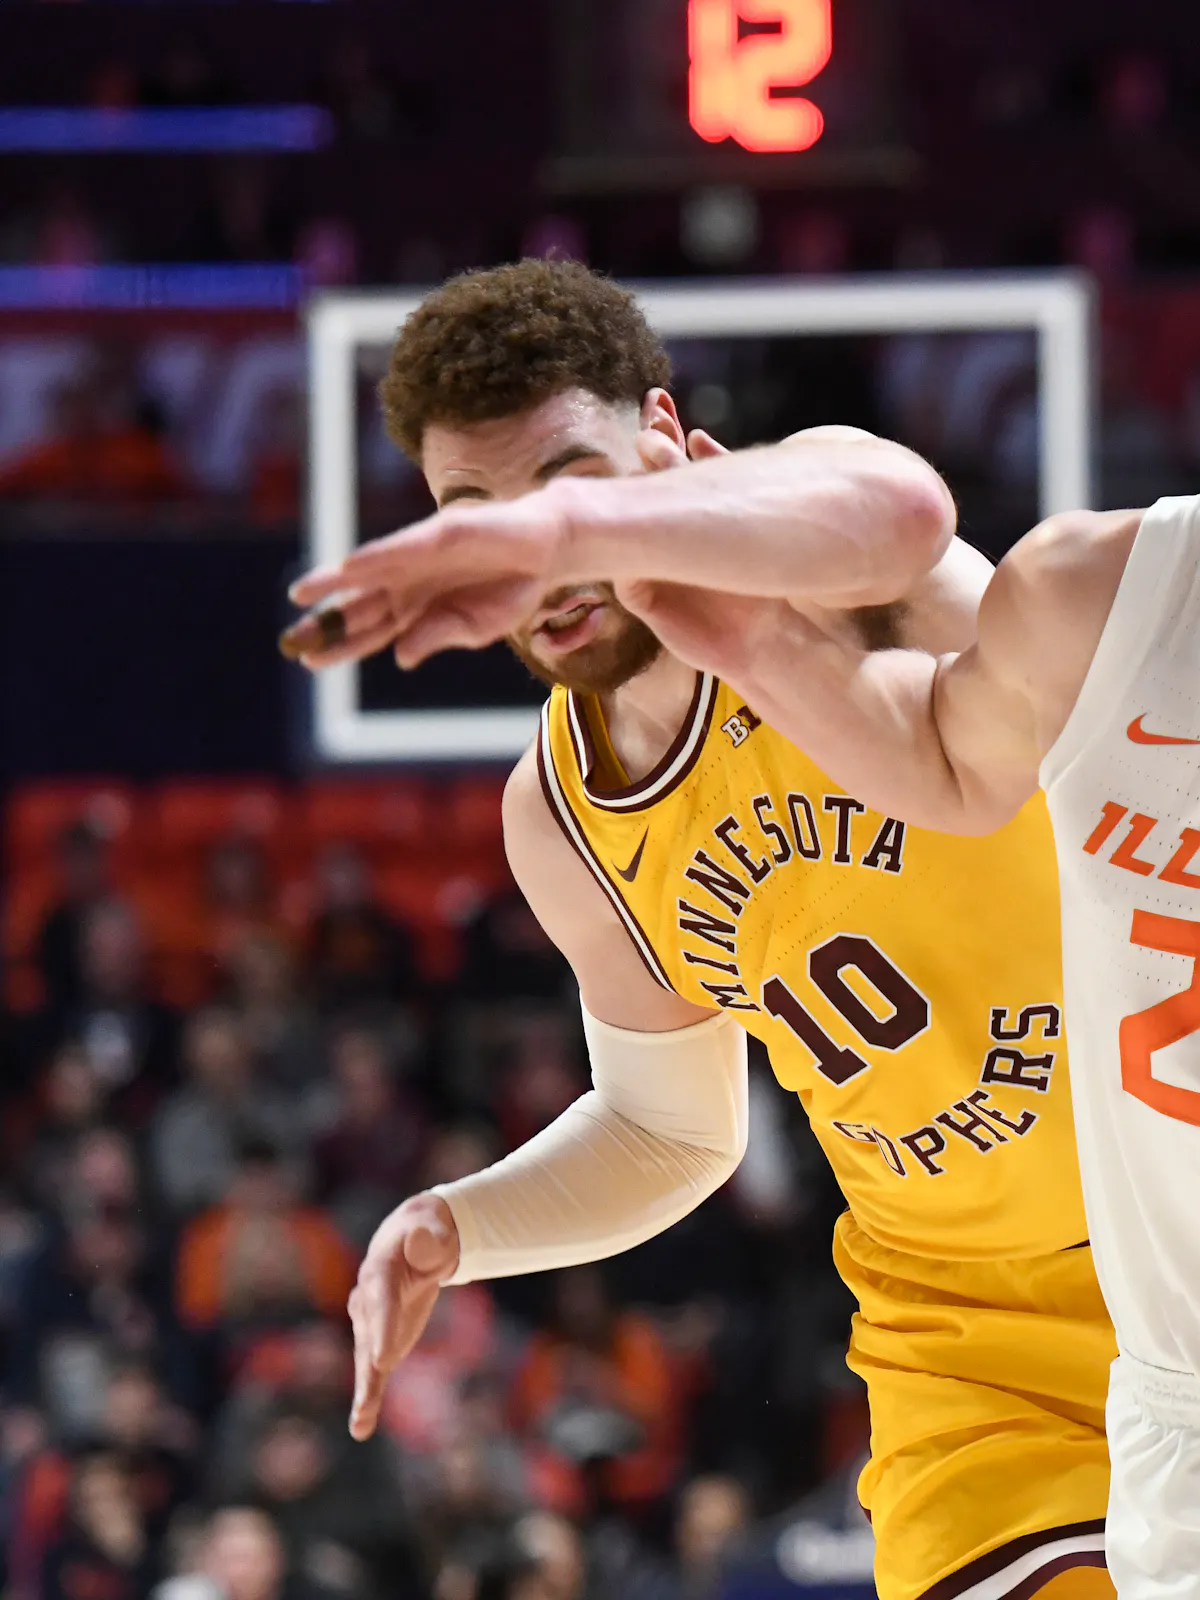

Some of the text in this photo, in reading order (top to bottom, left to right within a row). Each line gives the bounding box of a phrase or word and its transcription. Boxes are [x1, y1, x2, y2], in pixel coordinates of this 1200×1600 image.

[720, 704, 762, 748] B1
[677, 792, 907, 1012] MINNESOTA
[761, 932, 931, 1086] 10
[832, 1002, 1062, 1178] GOPHERS
